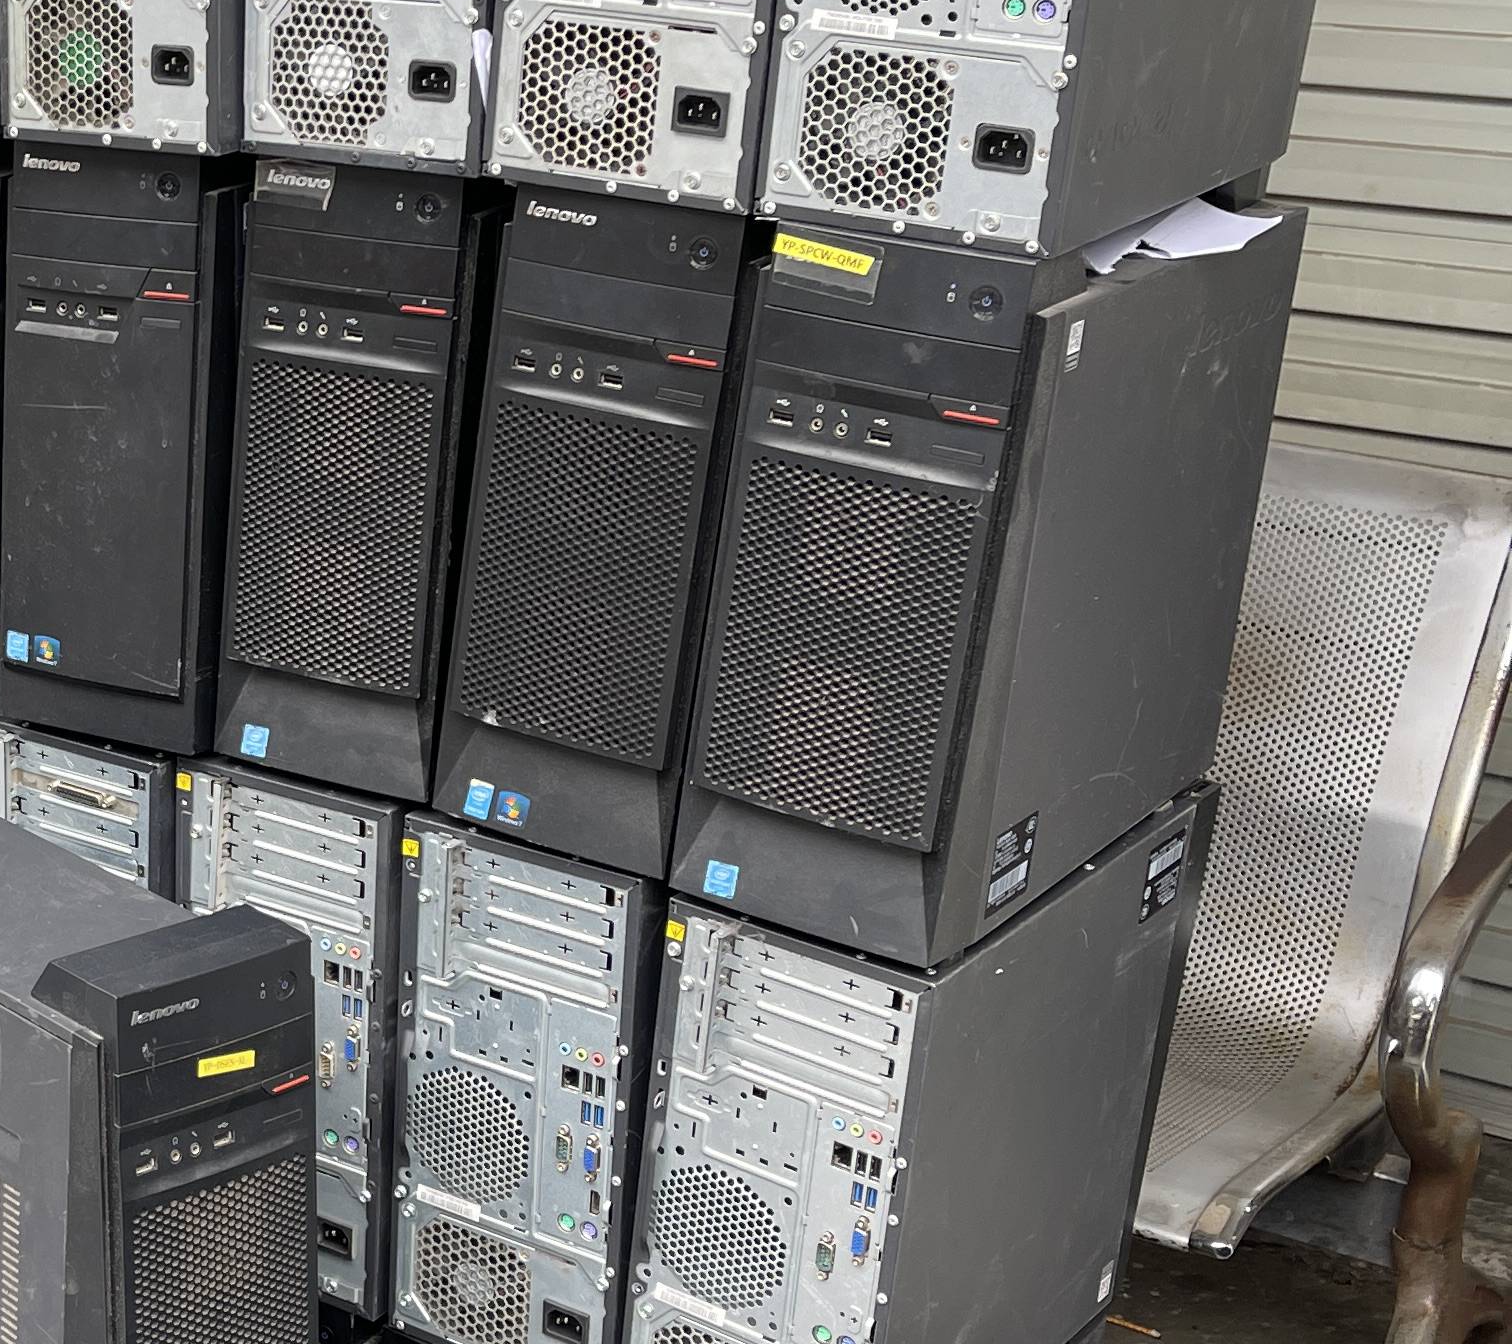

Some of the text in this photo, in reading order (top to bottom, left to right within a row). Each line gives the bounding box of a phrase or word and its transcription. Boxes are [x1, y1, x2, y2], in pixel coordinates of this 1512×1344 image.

[22, 153, 80, 172] lenovo
[267, 169, 331, 190] lenovo
[526, 200, 597, 226] lenovo
[130, 998, 200, 1026] lenovo
